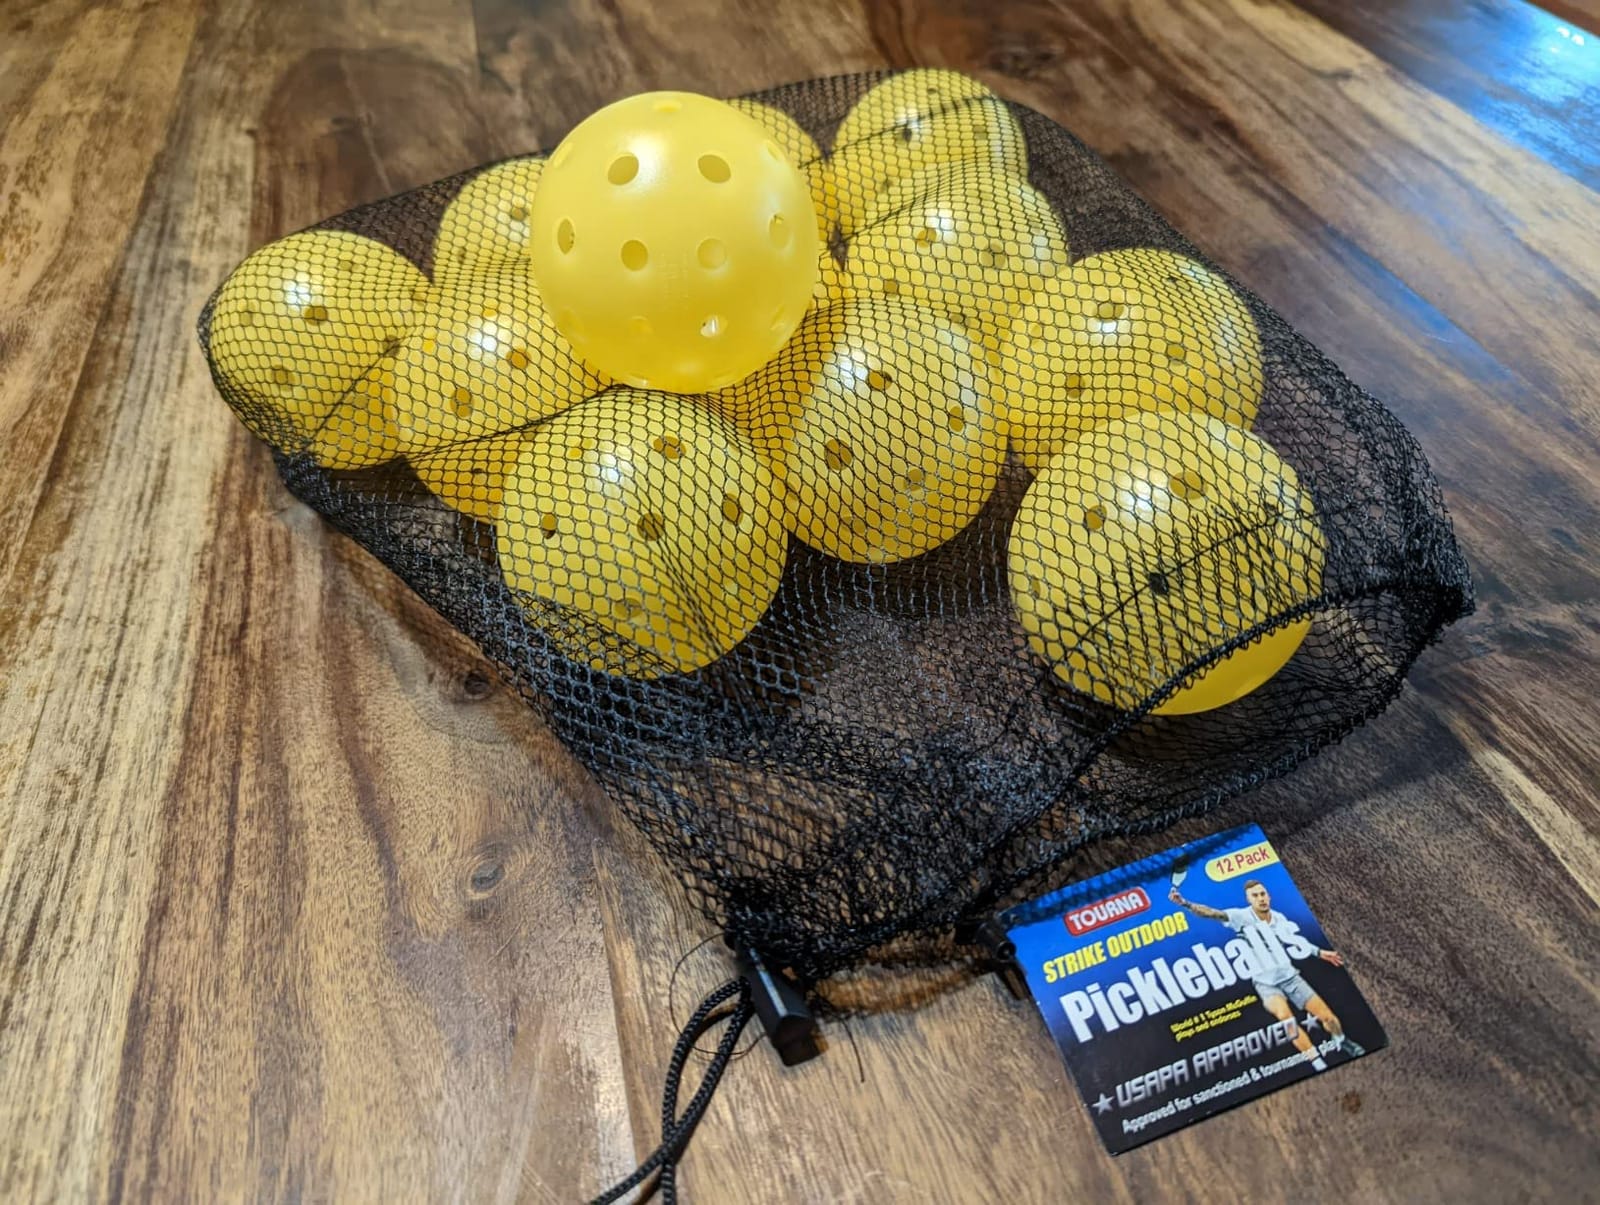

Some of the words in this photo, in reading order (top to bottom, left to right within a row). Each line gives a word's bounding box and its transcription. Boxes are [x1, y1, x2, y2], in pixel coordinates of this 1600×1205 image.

[1216, 858, 1234, 875] 12
[1236, 847, 1270, 868] Pack
[1069, 891, 1144, 930] TOURNA
[1043, 941, 1107, 983] STRIKE
[1106, 911, 1190, 958] OUTDOOR
[1059, 924, 1311, 1043] Pickleballs
[1115, 1059, 1190, 1108] USAPA
[1192, 1016, 1298, 1078] APPROVED
[1122, 1101, 1176, 1134] Approved
[1174, 1097, 1192, 1112] for
[1193, 1071, 1251, 1105] sanctioned
[1249, 1067, 1261, 1081] &
